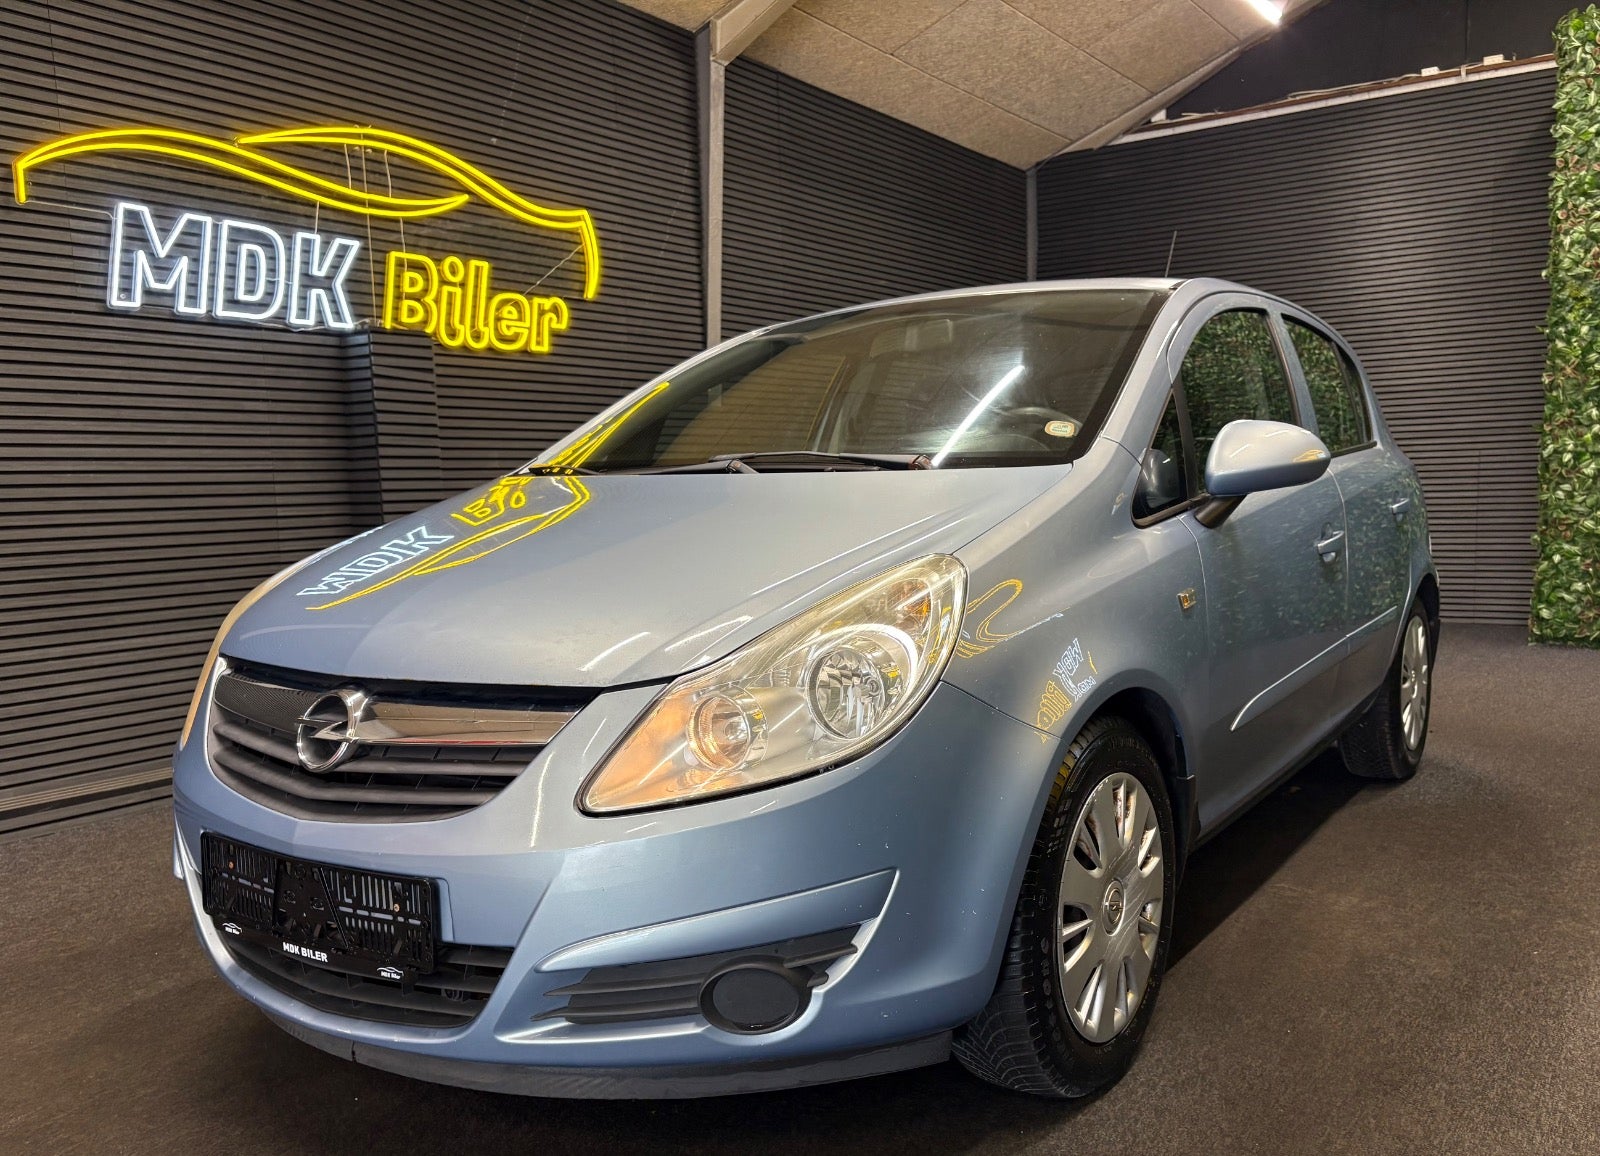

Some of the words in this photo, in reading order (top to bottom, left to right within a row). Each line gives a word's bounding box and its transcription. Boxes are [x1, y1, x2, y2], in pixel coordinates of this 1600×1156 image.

[107, 201, 361, 331] MDK
[383, 251, 569, 353] Biler
[282, 941, 300, 955] MDK
[300, 946, 329, 963] BILER
